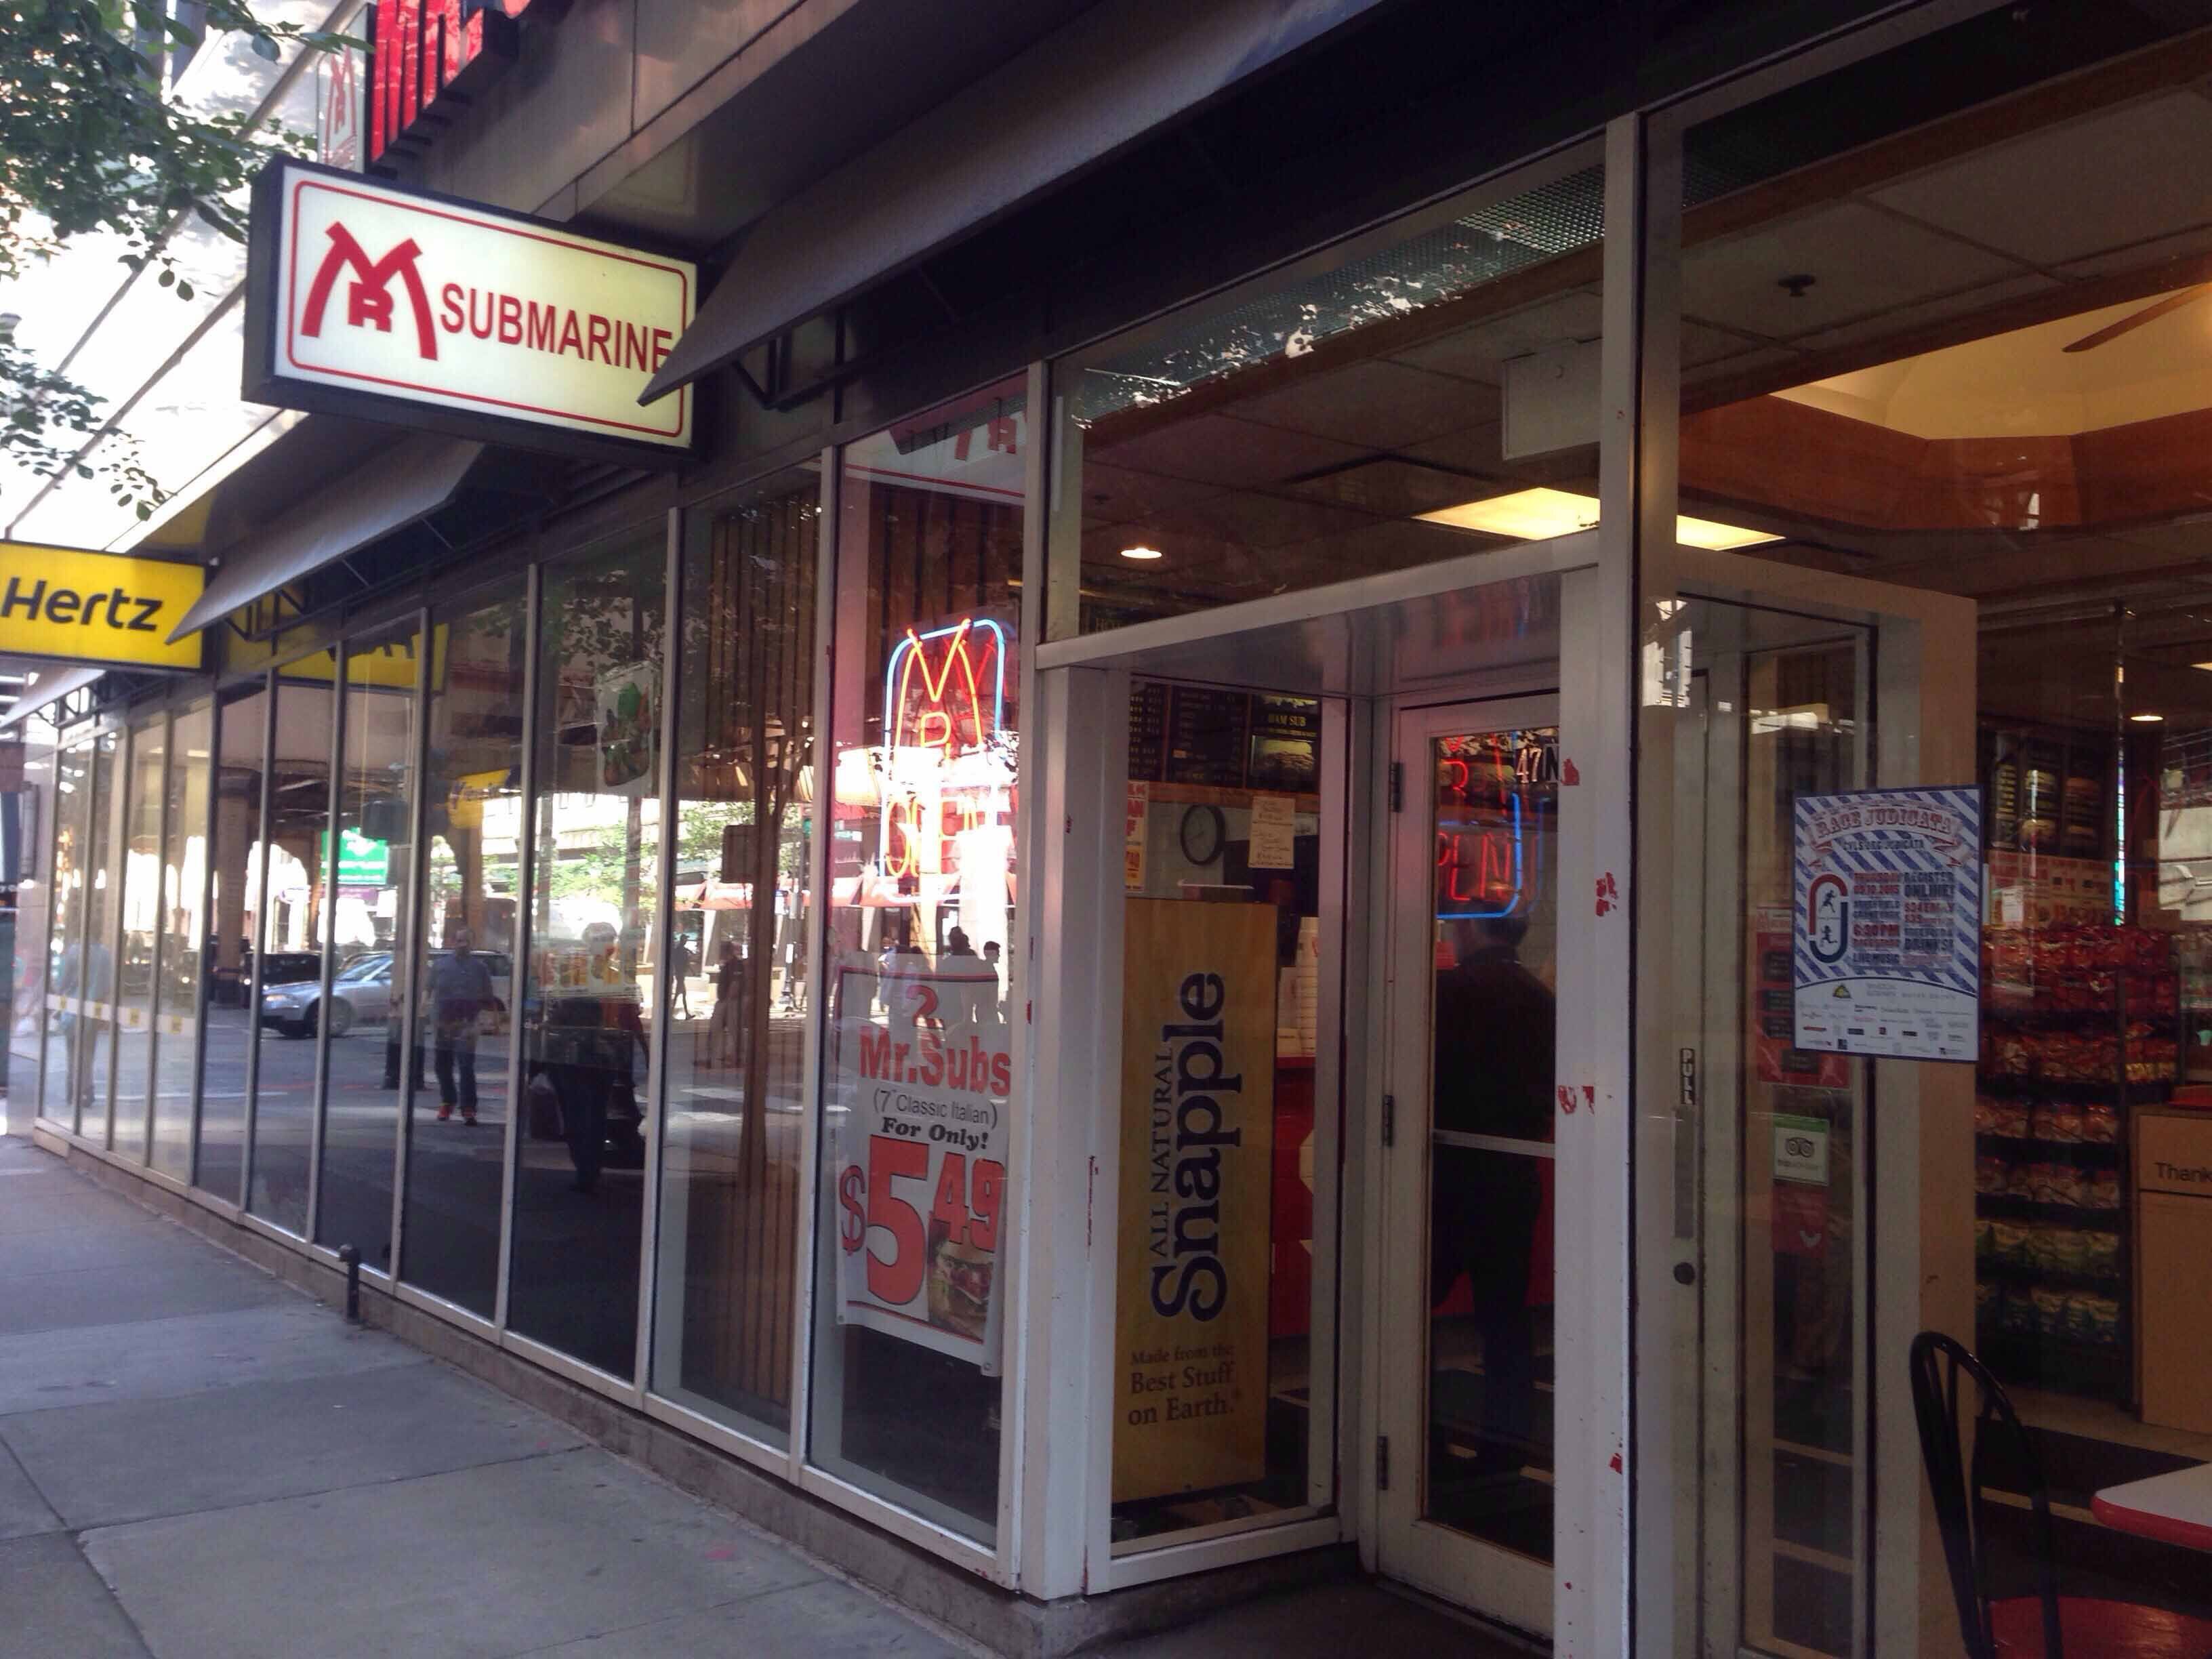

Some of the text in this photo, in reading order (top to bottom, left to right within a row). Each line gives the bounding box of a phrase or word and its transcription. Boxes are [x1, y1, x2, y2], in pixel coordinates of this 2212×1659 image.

[440, 282, 674, 374] SUBMARINE
[1, 577, 163, 632] Hertz
[905, 984, 944, 1029] 2
[1681, 1048, 1694, 1105] PULL
[896, 1093, 948, 1118] Classic
[882, 1117, 989, 1151] For Only!
[1149, 1047, 1174, 1258] ALL NATURAL
[1151, 972, 1243, 1322] Snapple
[2153, 1161, 2212, 1183] Thank
[1130, 1343, 1237, 1365] Made from the
[1130, 1359, 1237, 1395] Best Stuff
[1127, 1406, 1159, 1427] on
